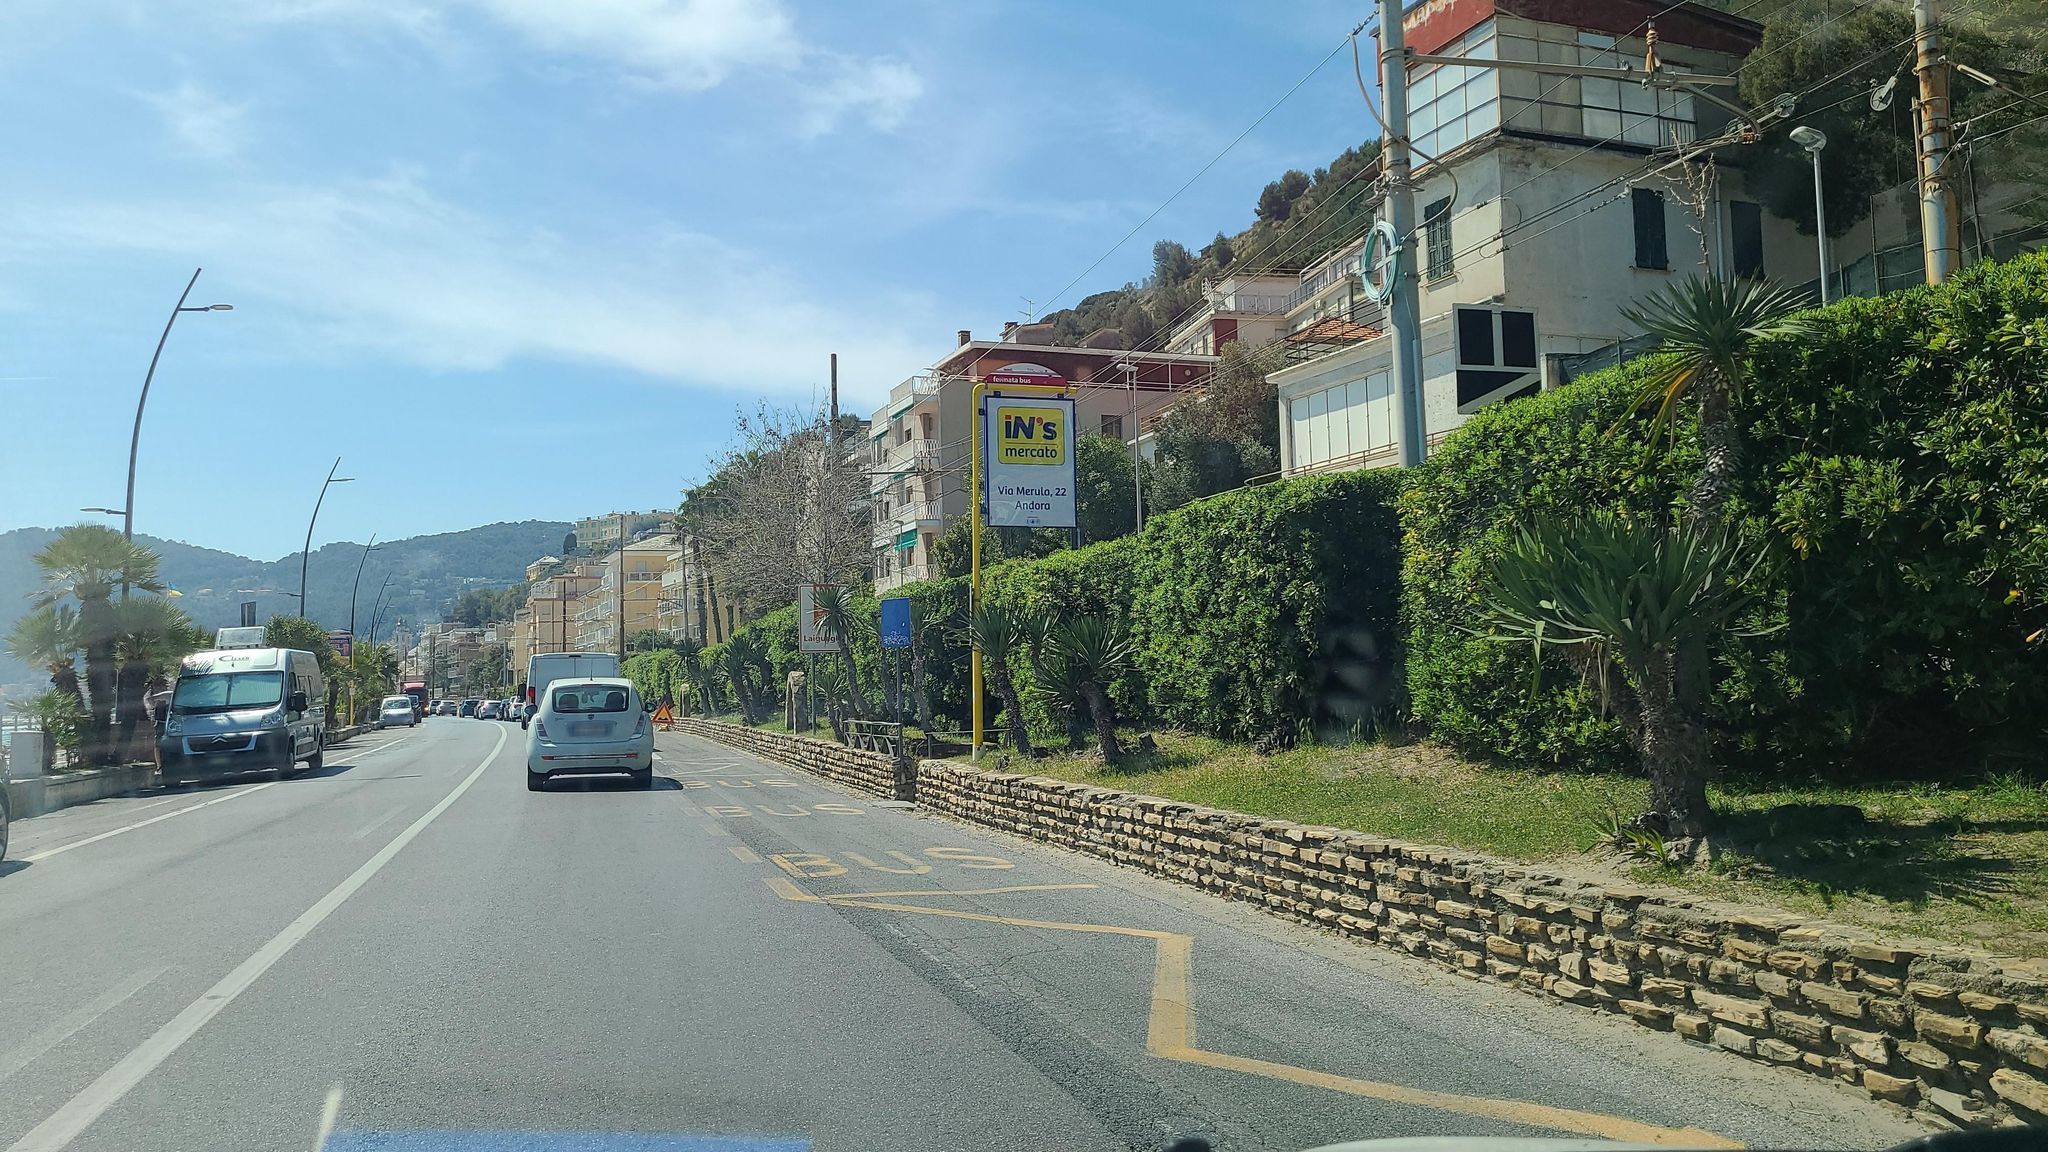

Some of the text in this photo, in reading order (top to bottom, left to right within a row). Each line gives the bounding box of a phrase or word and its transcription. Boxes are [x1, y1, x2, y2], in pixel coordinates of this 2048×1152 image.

[1019, 376, 1032, 384] bus
[1004, 414, 1058, 441] iN's
[1005, 446, 1058, 459] mercato
[998, 485, 1067, 498] Via Merula, 22
[1015, 500, 1051, 511] Andora
[683, 778, 798, 790] BUS
[703, 803, 866, 818] BUS
[770, 847, 1016, 878] BUS
